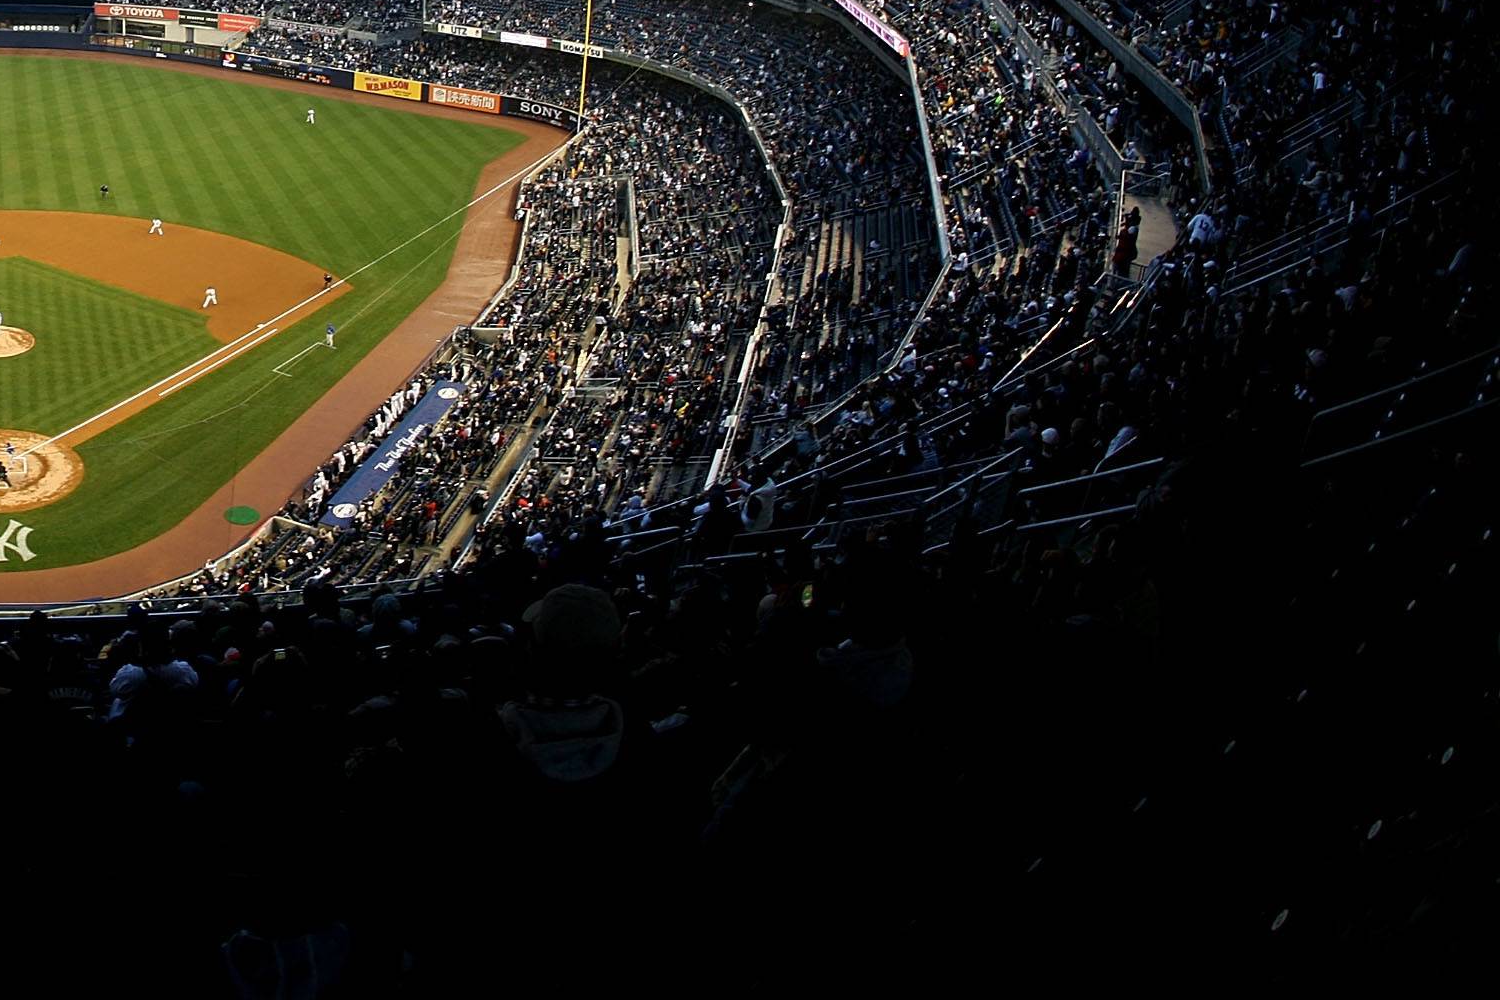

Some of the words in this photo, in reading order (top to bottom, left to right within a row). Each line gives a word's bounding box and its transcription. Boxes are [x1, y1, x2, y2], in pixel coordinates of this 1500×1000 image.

[124, 7, 164, 18] TOYOTA
[451, 25, 468, 35] UTZ
[520, 102, 563, 120] SONY
